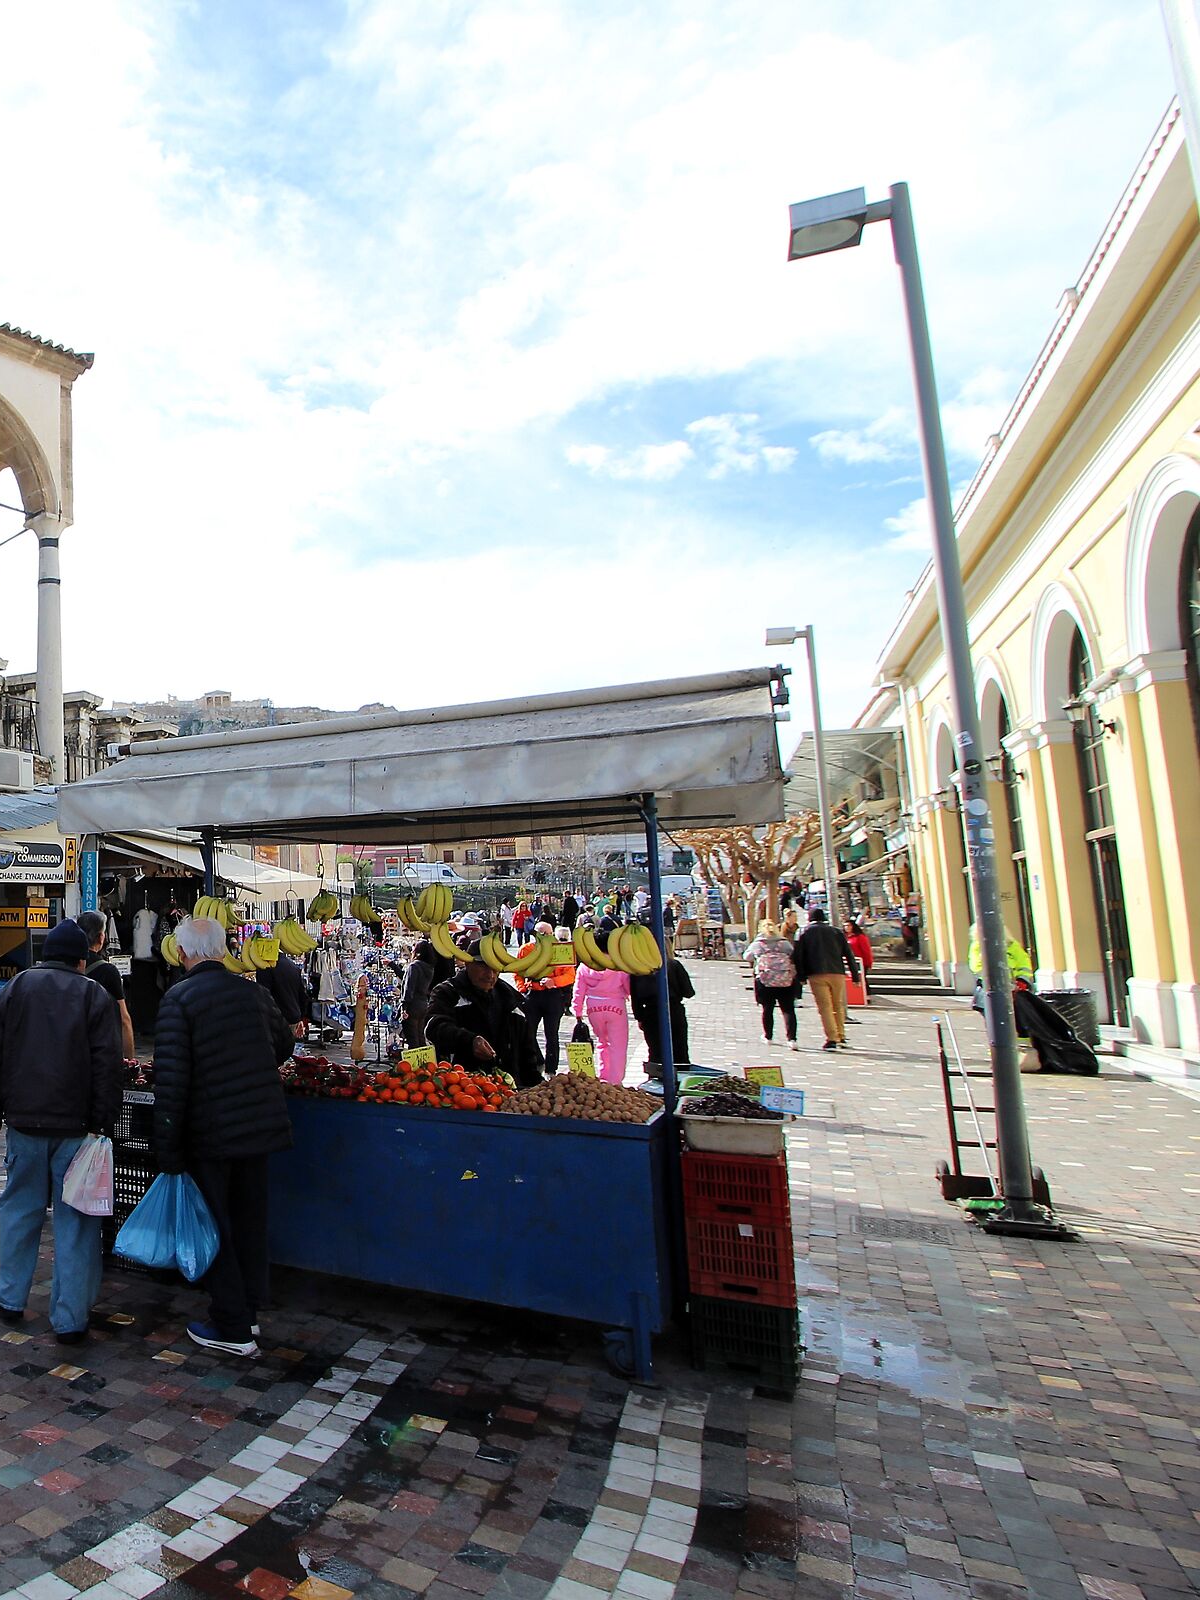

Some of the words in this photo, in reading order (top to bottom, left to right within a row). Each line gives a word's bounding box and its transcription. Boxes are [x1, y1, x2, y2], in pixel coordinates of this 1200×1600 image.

[17, 853, 61, 864] COMMISSION
[66, 840, 75, 881] ATM
[25, 873, 63, 881] ΣΥΝΑΛΛΑΓΜΑ
[86, 853, 94, 912] EXCHANG
[0, 912, 20, 922] ATM
[28, 913, 48, 922] ATM
